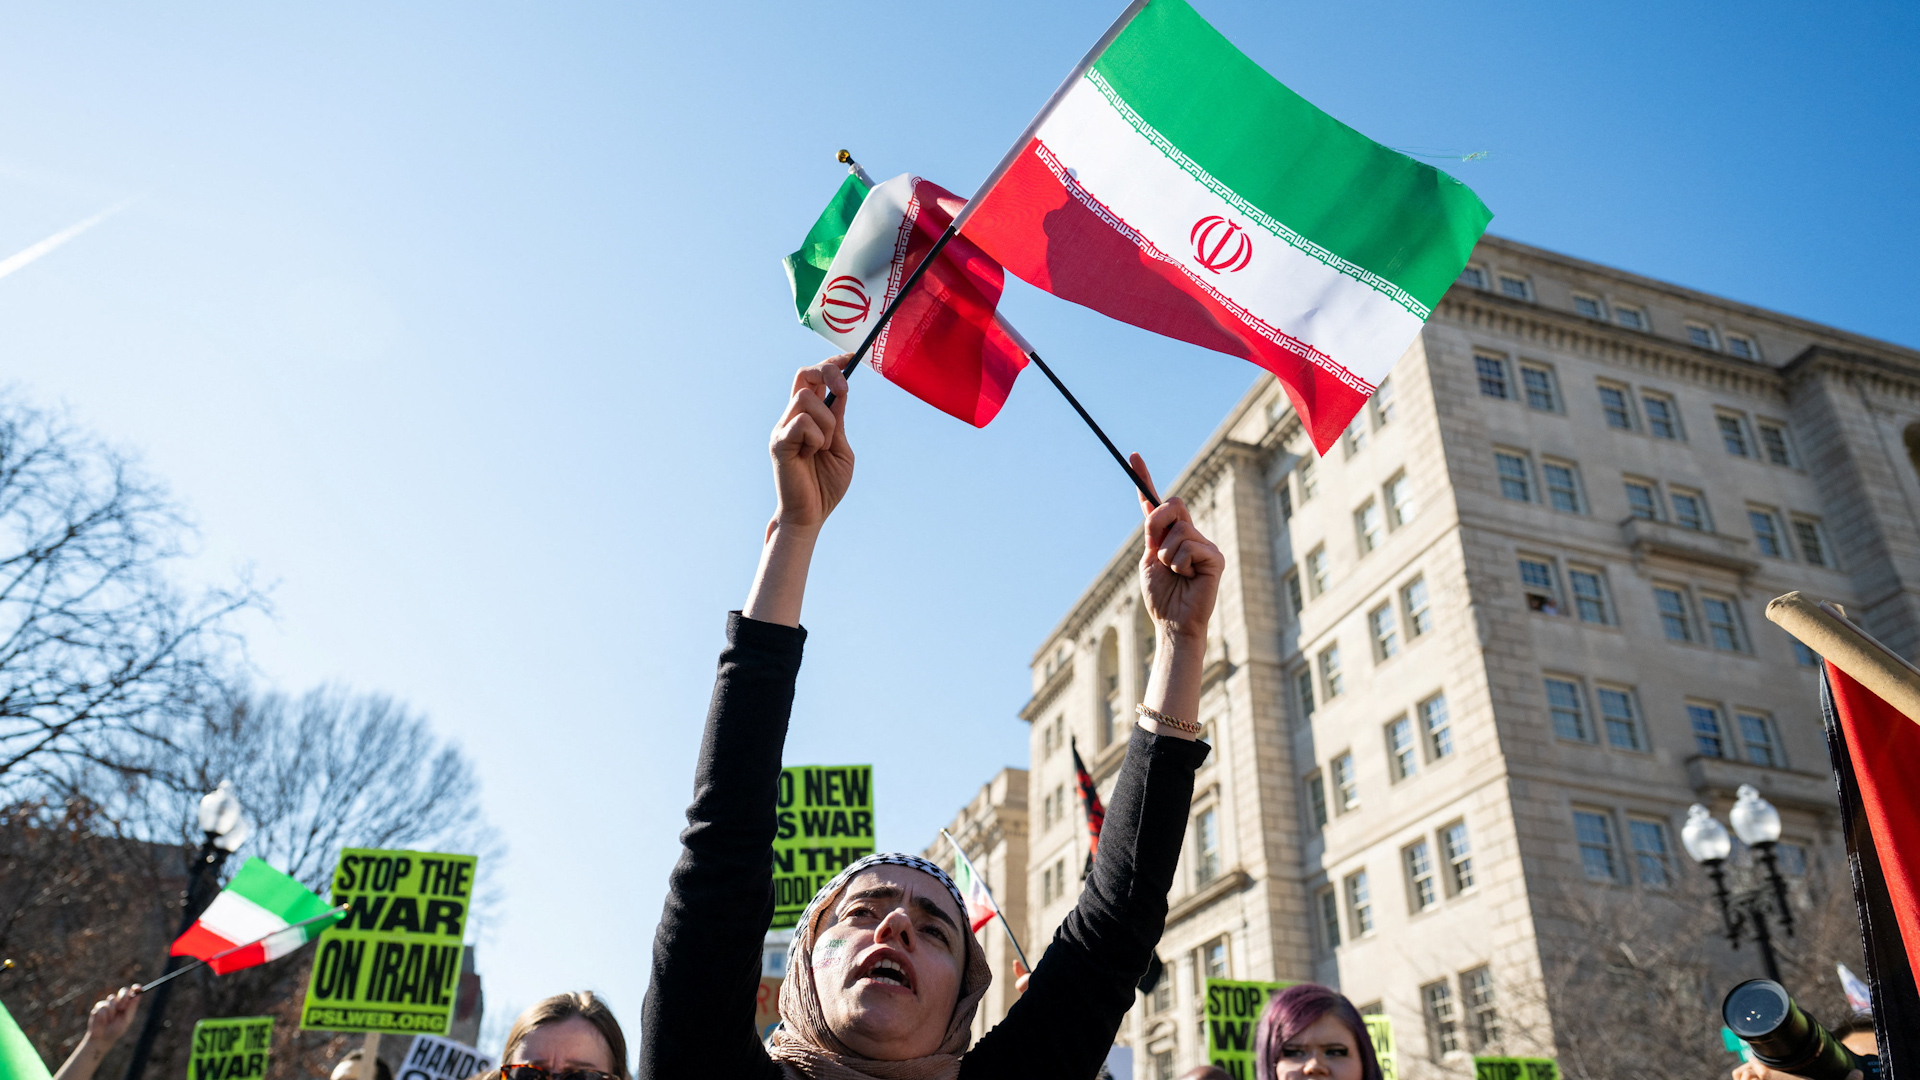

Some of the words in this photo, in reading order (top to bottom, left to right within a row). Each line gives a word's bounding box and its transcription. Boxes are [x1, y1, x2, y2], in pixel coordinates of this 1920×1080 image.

[778, 771, 794, 808] O
[804, 768, 869, 807] NEW
[778, 811, 797, 839] S
[801, 810, 872, 837] WAR
[337, 855, 411, 892] STOP
[419, 859, 471, 897] THE
[334, 894, 463, 936] WAR
[315, 939, 365, 1001] ON
[365, 941, 460, 1006] IRAN!
[1209, 984, 1262, 1018] STOP
[308, 1008, 445, 1030] PSLWEB.ORG
[196, 1026, 242, 1054] STOP
[244, 1024, 269, 1050] THE
[194, 1054, 263, 1080] WAR
[1477, 1062, 1521, 1080] STOP
